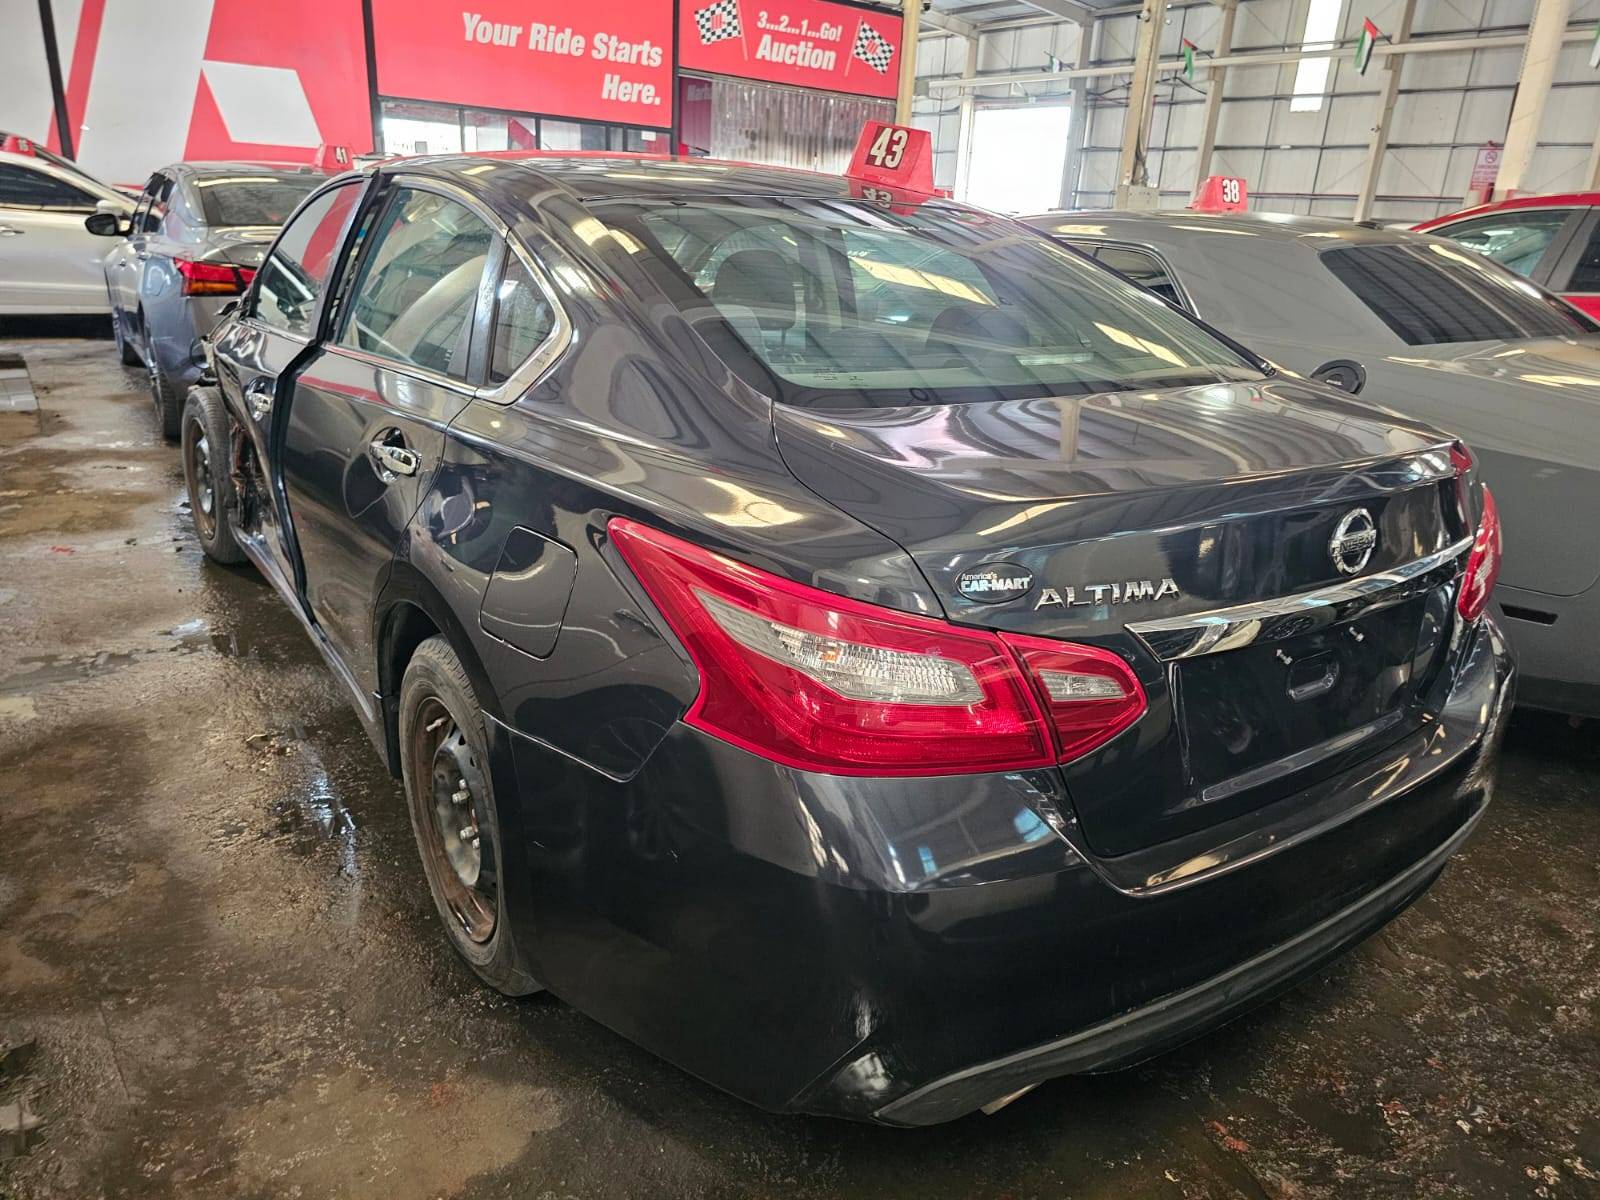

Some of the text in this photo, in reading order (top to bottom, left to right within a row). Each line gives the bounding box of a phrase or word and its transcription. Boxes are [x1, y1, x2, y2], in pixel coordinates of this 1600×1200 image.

[462, 12, 664, 68] Your Ride Starts
[755, 34, 837, 71] Auction
[601, 73, 662, 106] Here.
[335, 146, 348, 165] 41
[869, 127, 908, 168] 43
[1222, 179, 1240, 203] 38
[960, 577, 1031, 592] CAR-MART
[961, 572, 997, 580] America's
[1033, 578, 1182, 611] ALTIMA
